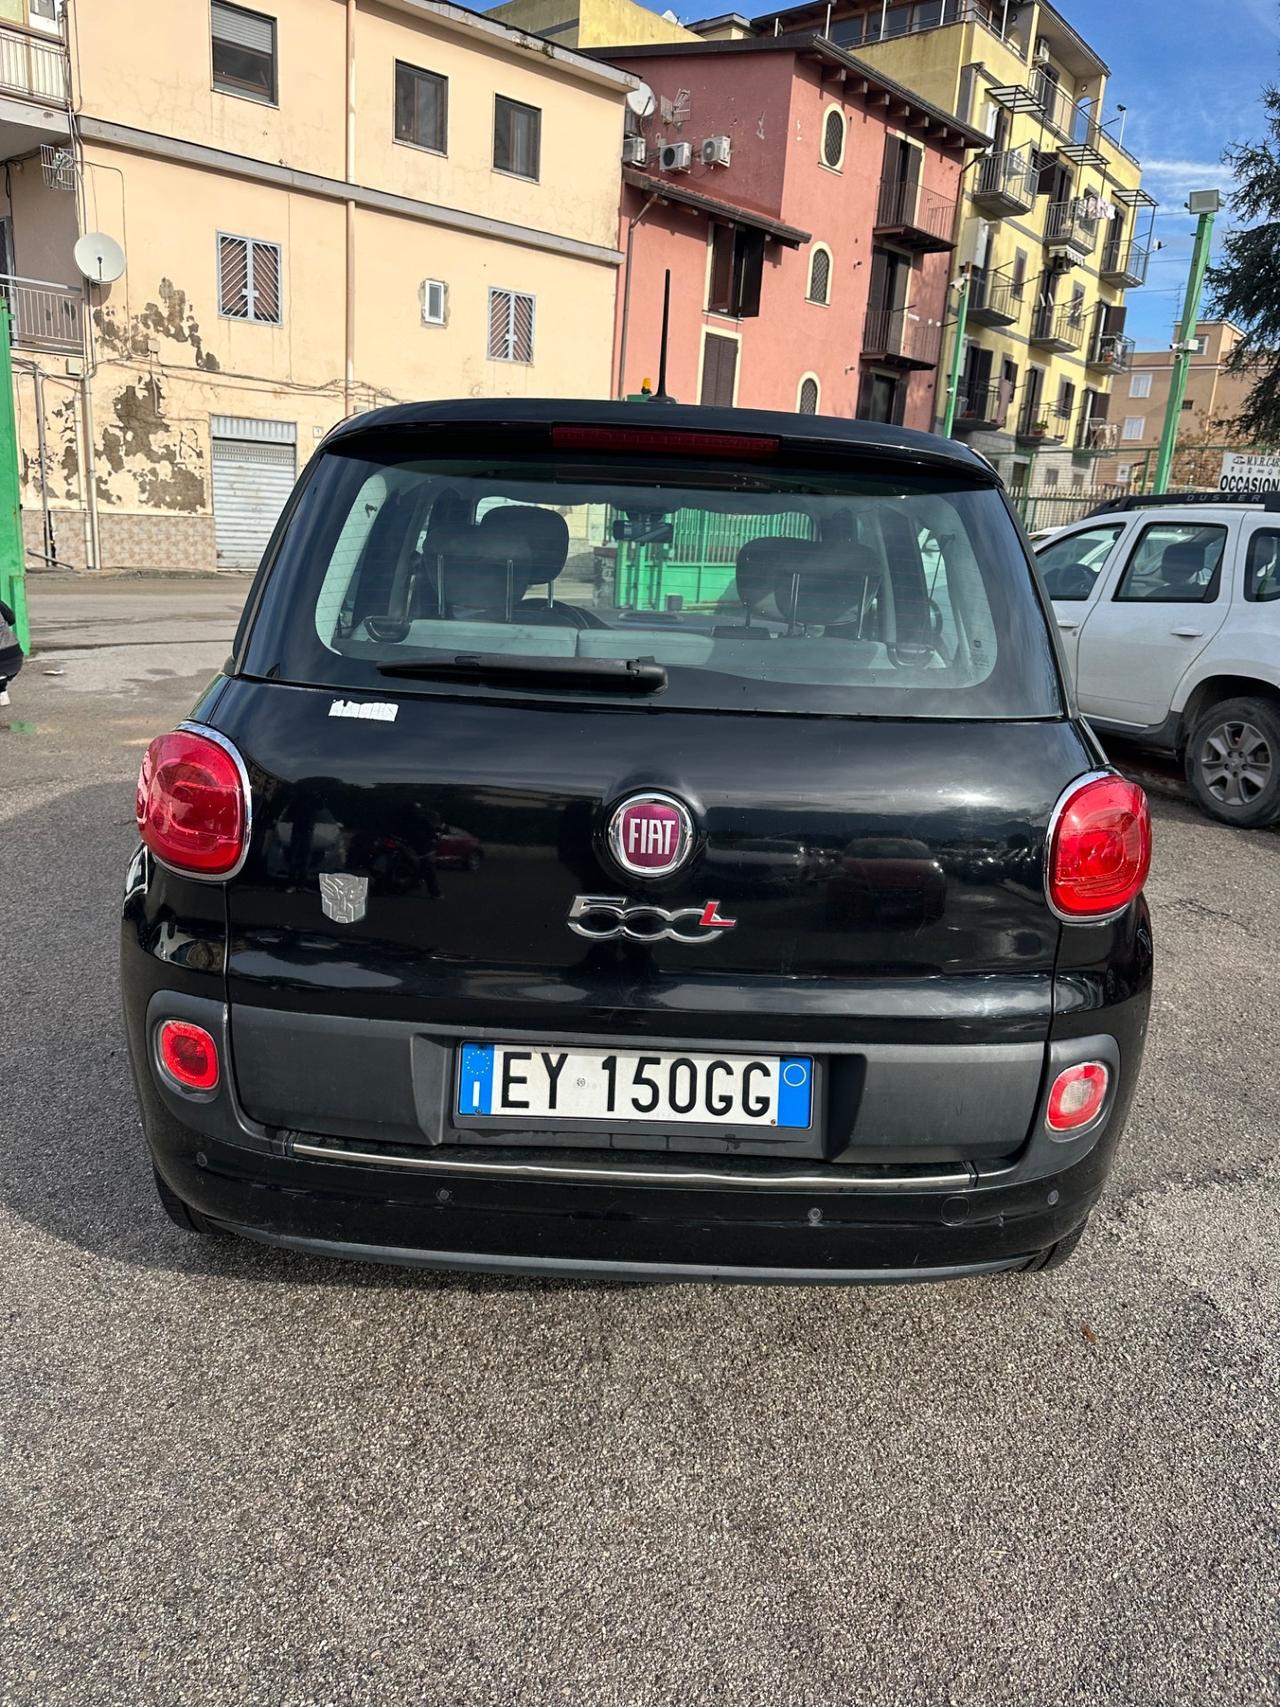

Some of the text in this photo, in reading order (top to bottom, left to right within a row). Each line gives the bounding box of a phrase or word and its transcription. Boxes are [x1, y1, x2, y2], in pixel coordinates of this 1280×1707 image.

[1186, 494, 1261, 502] DUSTER
[628, 818, 676, 855] FIAT
[567, 895, 737, 943] 500L
[501, 1051, 771, 1118] EY 150GG
